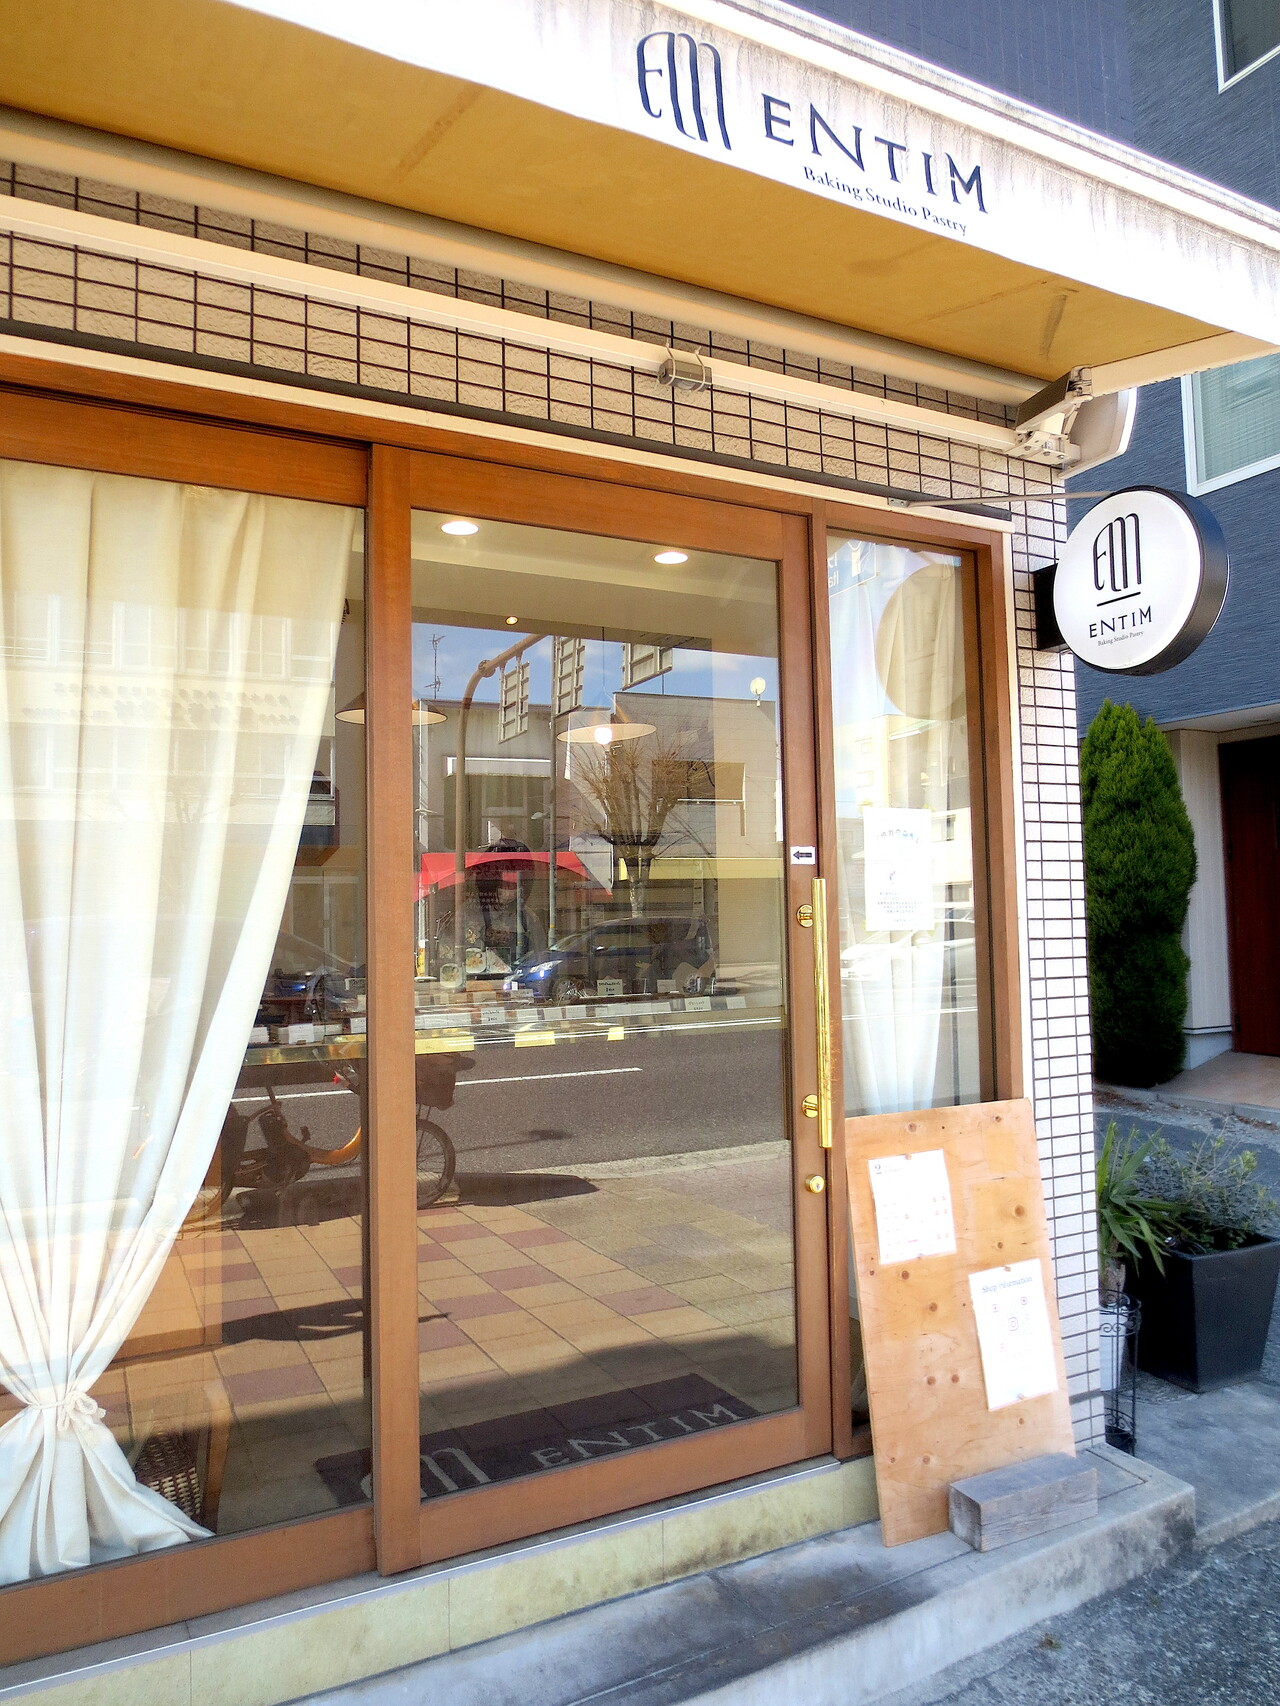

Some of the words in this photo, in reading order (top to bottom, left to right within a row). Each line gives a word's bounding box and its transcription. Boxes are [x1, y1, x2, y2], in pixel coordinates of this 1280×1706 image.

[761, 92, 989, 214] ENTIM
[803, 166, 864, 201] Baking
[866, 187, 918, 216] Studio
[921, 206, 967, 236] Pastry
[1089, 605, 1152, 638] ENTIM
[1097, 638, 1114, 647] Baking
[1113, 635, 1129, 643] Studio
[1129, 631, 1144, 639] Pastry
[531, 1402, 743, 1468] ENTIM
